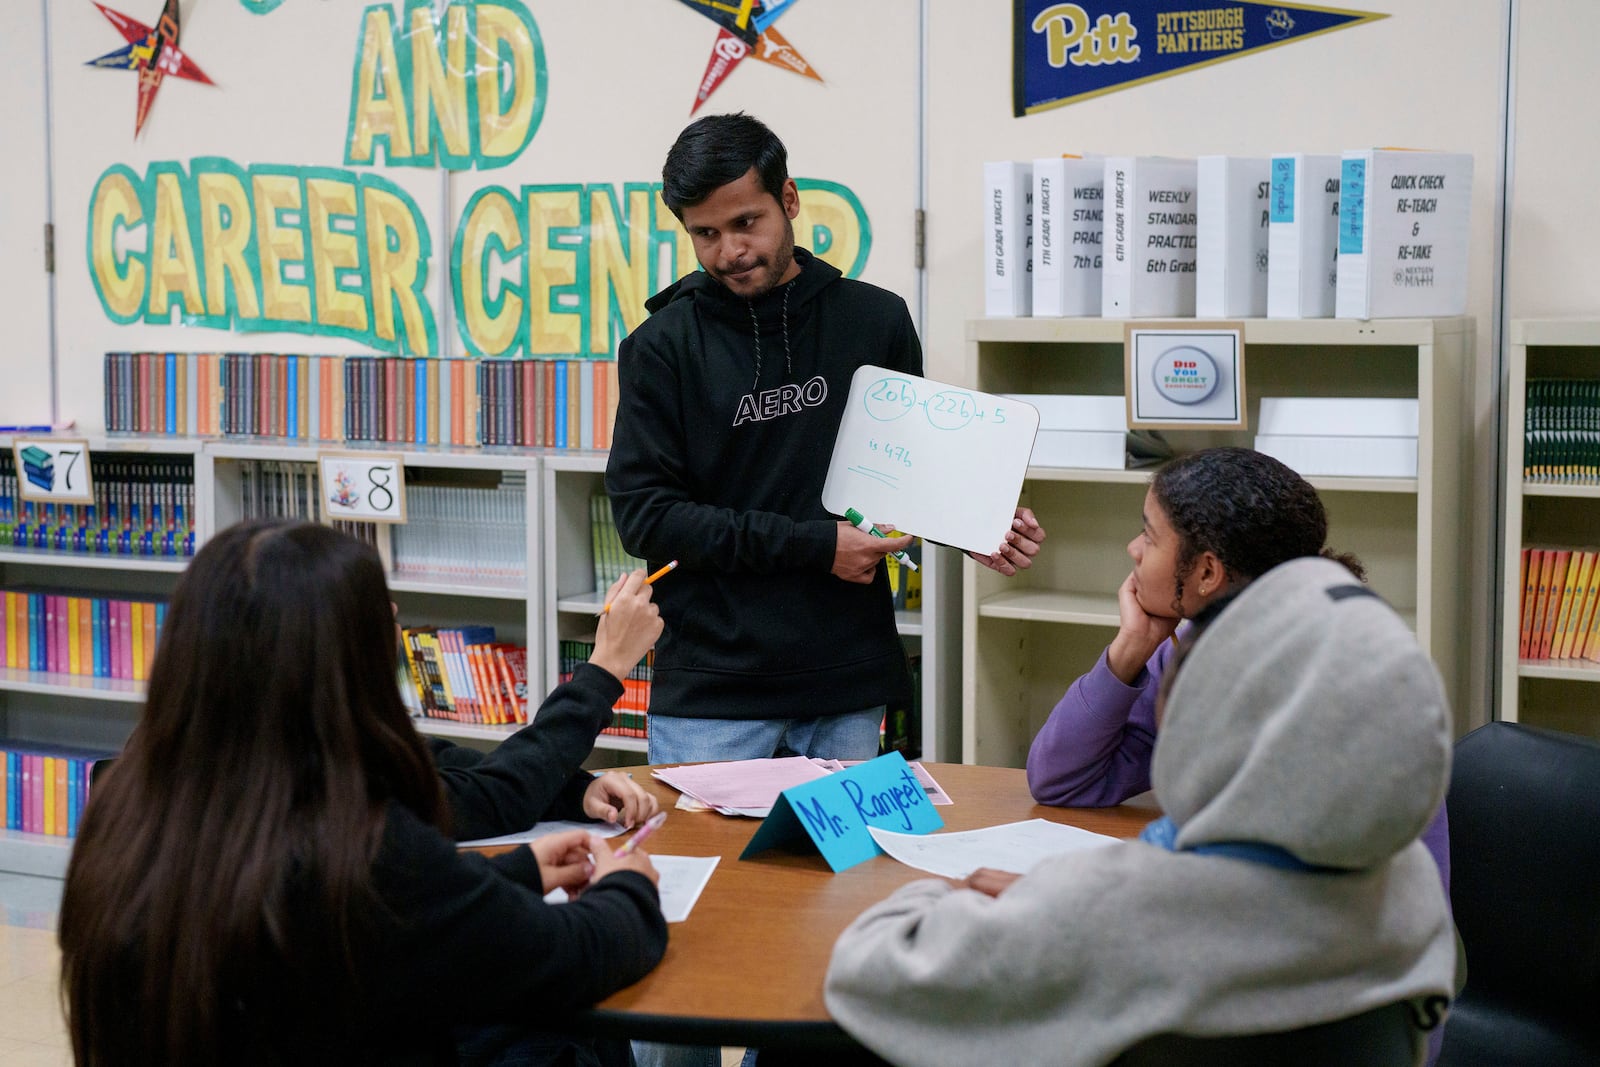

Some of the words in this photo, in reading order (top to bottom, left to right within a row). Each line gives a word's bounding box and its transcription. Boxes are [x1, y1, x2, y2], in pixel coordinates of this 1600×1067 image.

[1156, 8, 1245, 33] PITTSBURGH
[1032, 3, 1141, 68] Pitt
[1156, 28, 1245, 54] PANTHERS
[344, 0, 548, 171] AND
[1073, 187, 1104, 200] WEEK
[1115, 170, 1125, 209] TARGETS
[1391, 175, 1417, 190] QUICK
[1418, 174, 1446, 190] CHECK
[994, 188, 1003, 226] TARGETS
[1041, 177, 1050, 216] TARGETS
[1148, 190, 1191, 203] WEEKLY
[1397, 198, 1438, 213] RE-TEACH
[1073, 209, 1104, 221] STAND
[1115, 212, 1125, 242] GRADE
[1147, 212, 1197, 225] STANDAR
[1041, 217, 1051, 248] GRADE
[1073, 232, 1103, 244] PRAC
[1412, 221, 1421, 237] &
[995, 228, 1004, 258] GRADE
[1115, 244, 1125, 262] 6TH
[1147, 235, 1197, 249] PRACTIC
[1397, 244, 1433, 260] RE-TAKE
[87, 156, 438, 356] CAREER
[452, 178, 872, 359] CEN
[1042, 250, 1051, 266] 7TH
[1073, 255, 1091, 269] 7th
[1146, 259, 1167, 273] 6th
[1169, 259, 1197, 273] Grad
[732, 375, 828, 426] AERO
[59, 450, 81, 490] 7
[368, 466, 393, 512] 8
[796, 796, 850, 842] Mr.
[840, 769, 924, 831] Ranjeet
